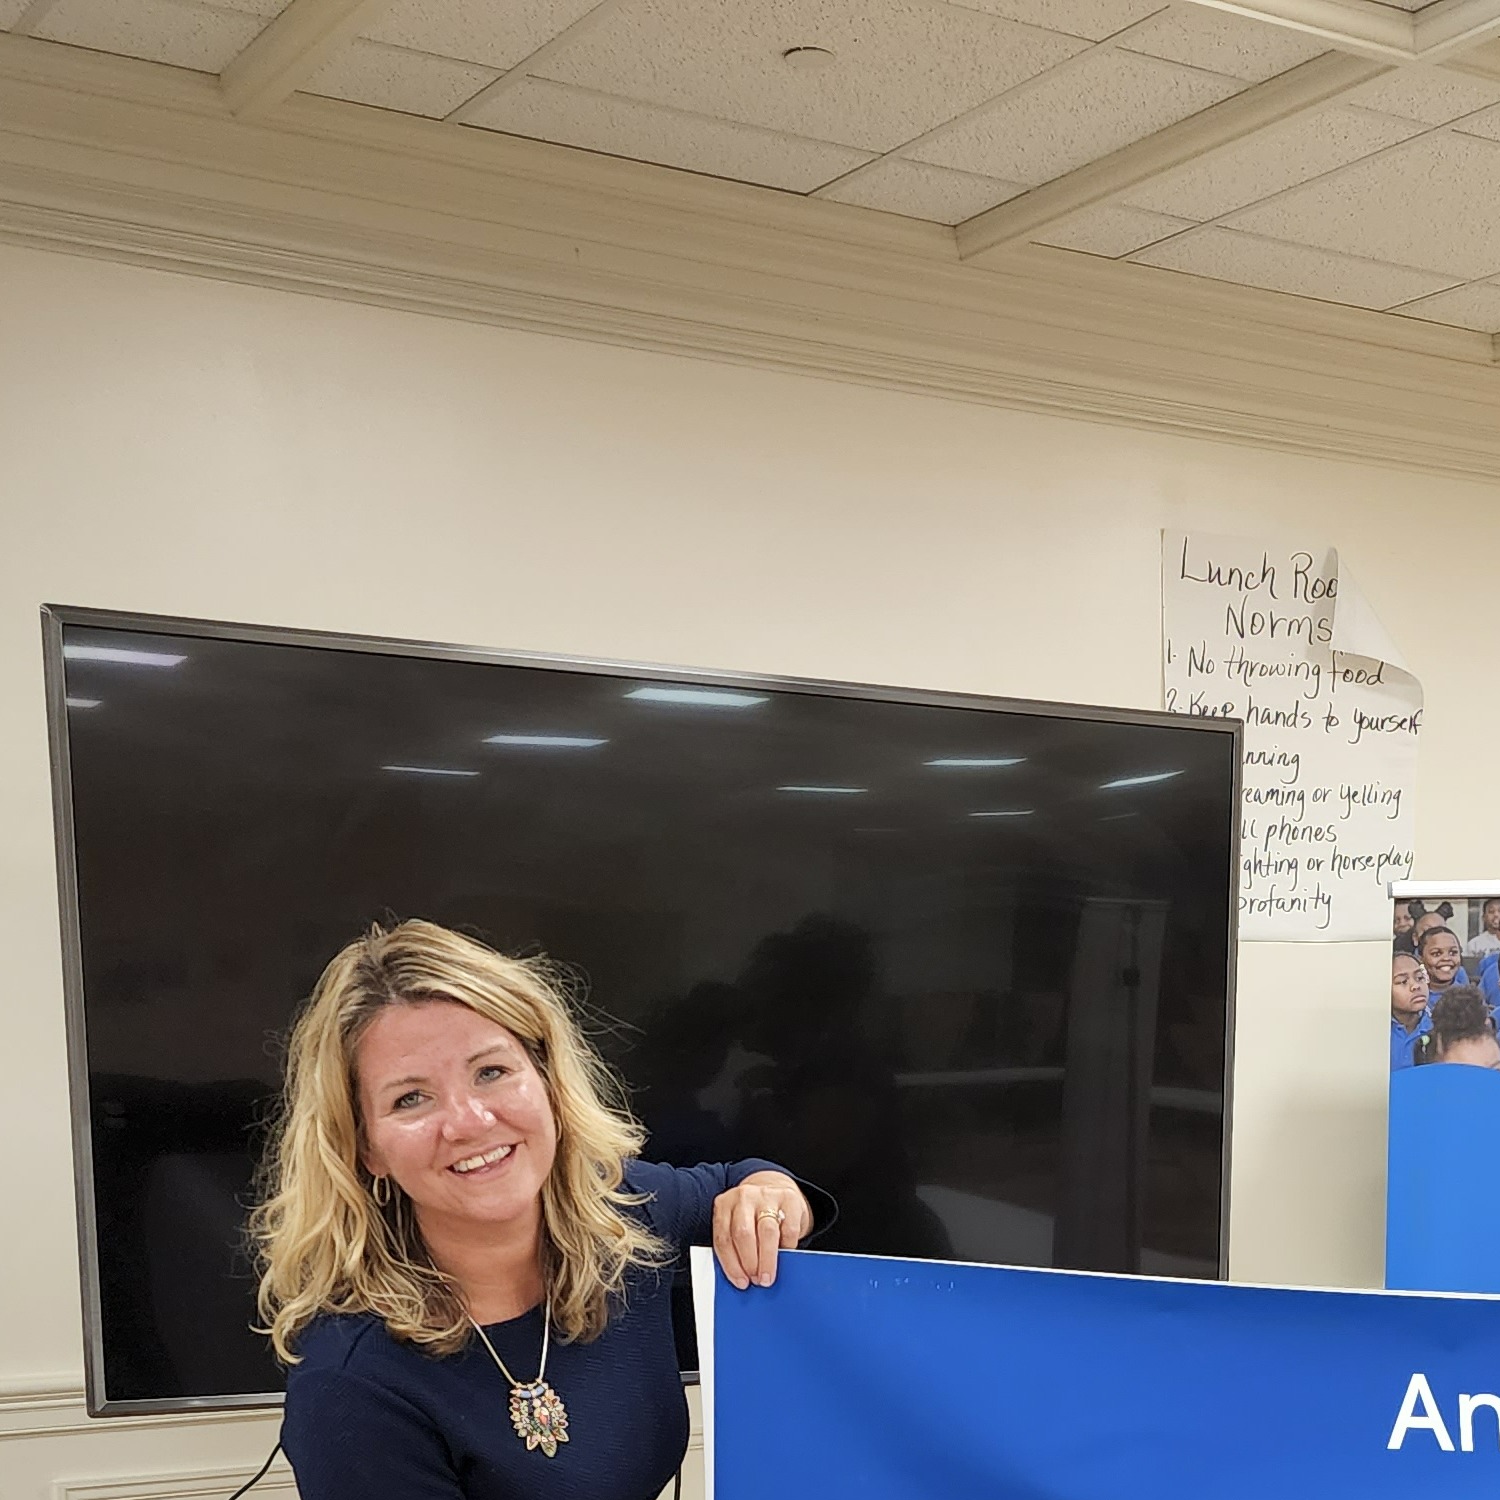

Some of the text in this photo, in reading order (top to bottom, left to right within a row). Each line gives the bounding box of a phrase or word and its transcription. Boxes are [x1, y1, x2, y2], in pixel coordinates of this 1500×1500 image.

[1181, 536, 1338, 603] Lunch Roo
[1225, 595, 1332, 645] Norms
[1188, 640, 1215, 677] No
[1223, 645, 1320, 699] throwing
[1327, 650, 1384, 692] food
[1190, 690, 1235, 717] Keep
[1246, 695, 1312, 729] hands
[1322, 702, 1339, 733] to
[1348, 707, 1423, 744] yourself
[1242, 745, 1299, 784] nning
[1241, 781, 1401, 822] reaming or yelling
[1241, 815, 1337, 852] ll phones
[1240, 847, 1298, 891] ghting
[1307, 857, 1324, 873] or
